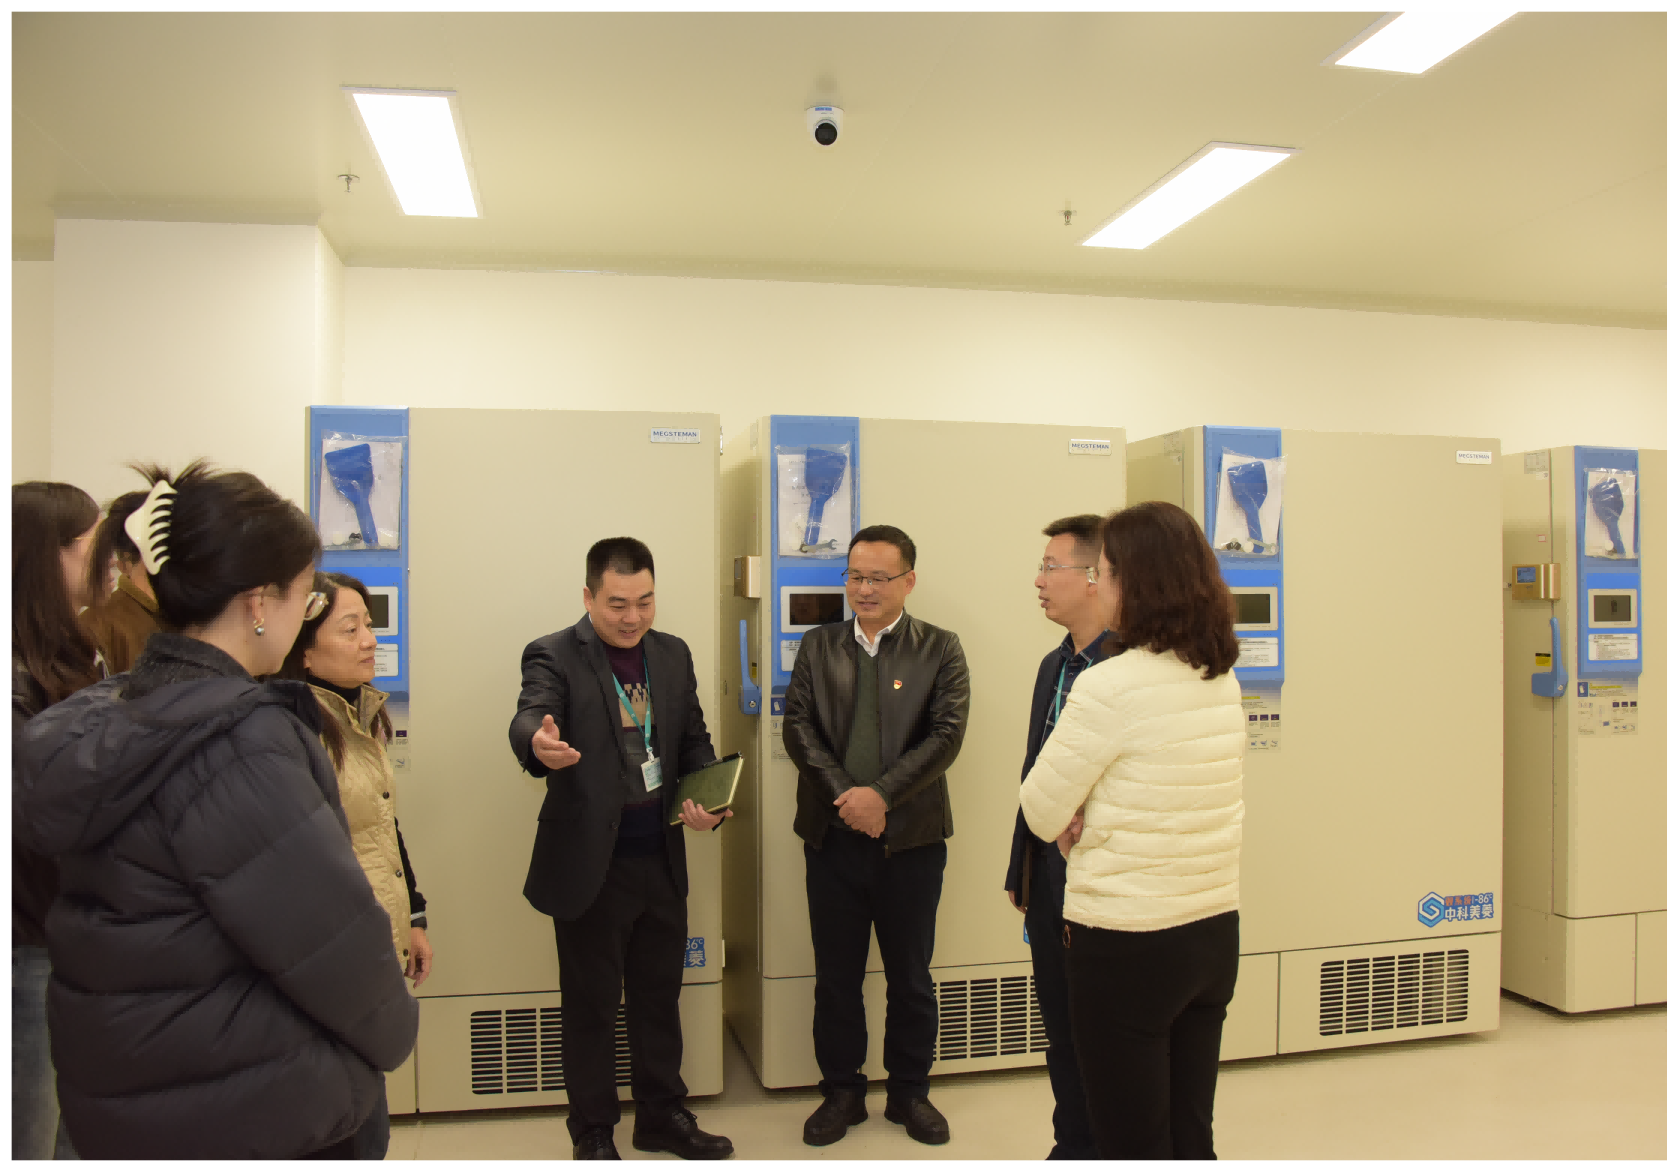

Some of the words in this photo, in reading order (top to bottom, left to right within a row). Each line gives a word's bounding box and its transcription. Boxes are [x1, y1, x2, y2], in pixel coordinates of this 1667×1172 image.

[1445, 903, 1492, 920] 中科美菱
[684, 950, 704, 966] 菱
